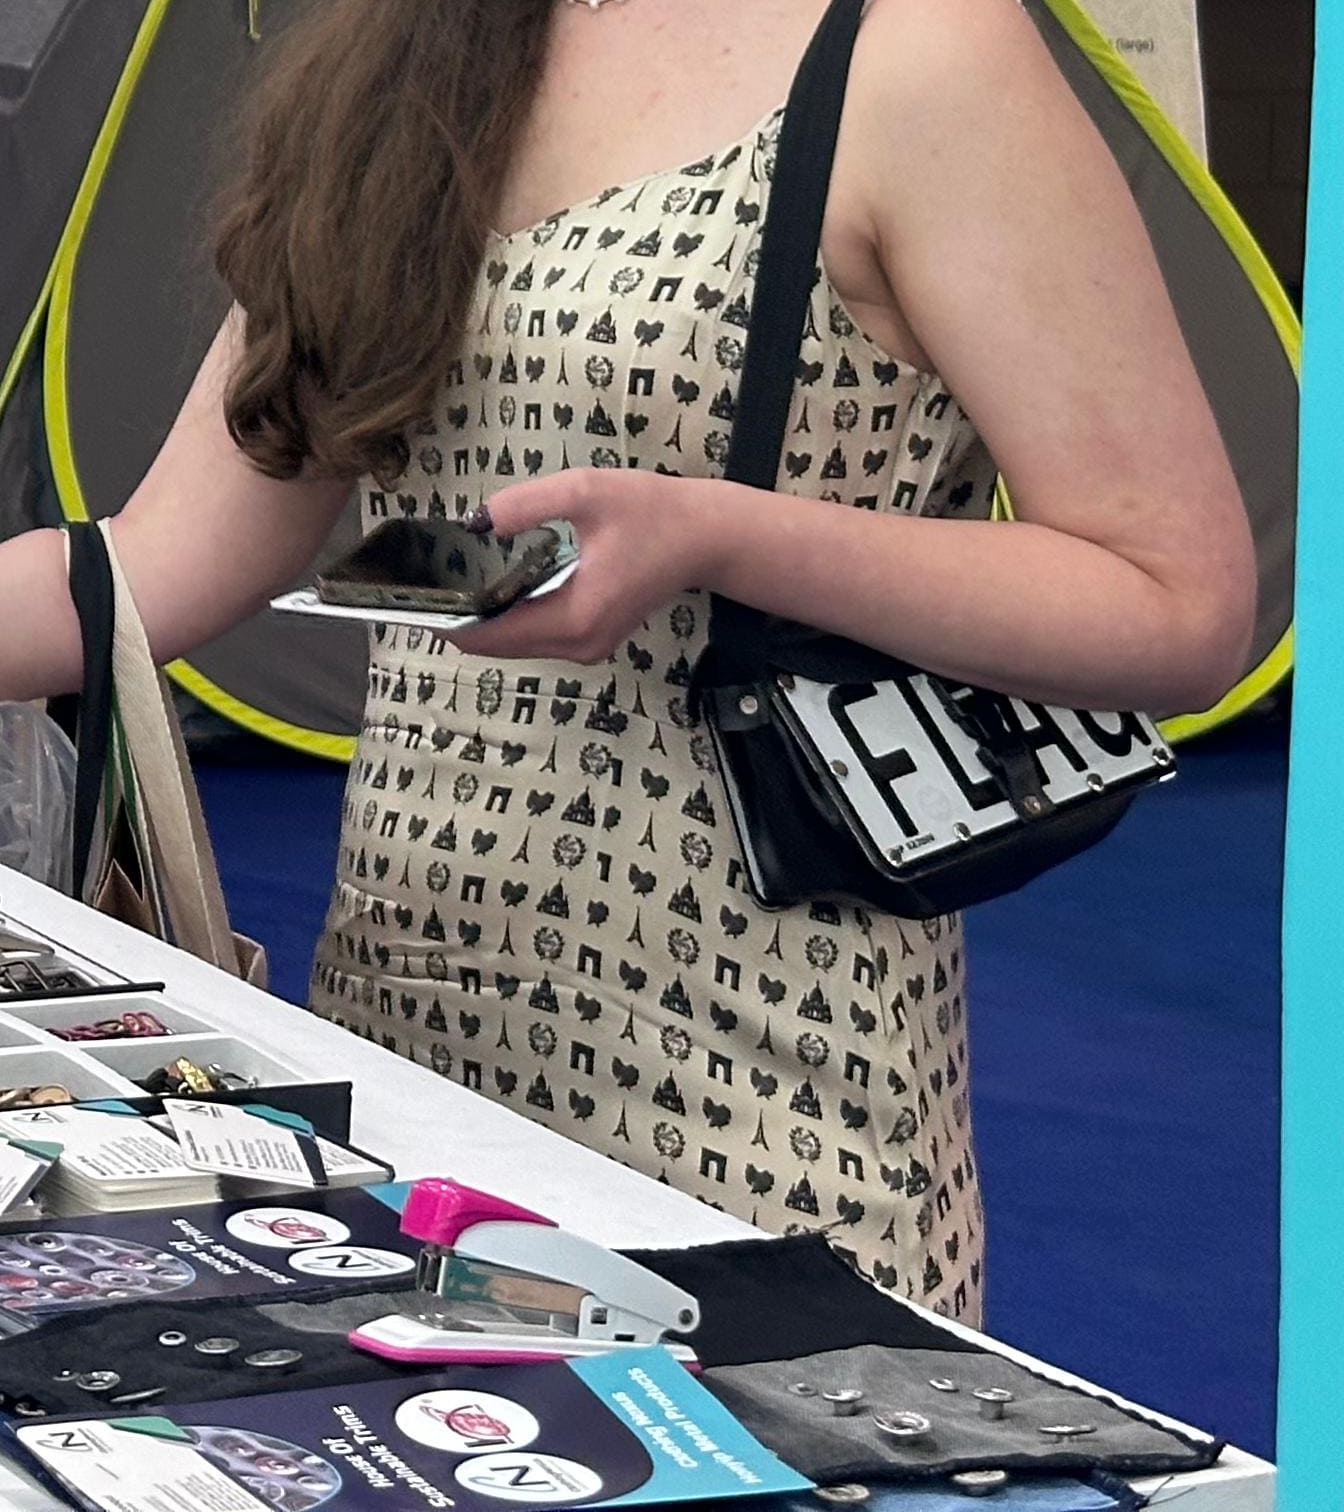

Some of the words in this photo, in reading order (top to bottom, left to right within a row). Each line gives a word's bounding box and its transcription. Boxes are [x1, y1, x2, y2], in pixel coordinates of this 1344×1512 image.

[627, 1367, 687, 1421] Products
[332, 1405, 378, 1445] Trims
[674, 1420, 719, 1452] Metal
[321, 1437, 354, 1455] Of
[344, 1454, 395, 1488] House
[368, 1444, 456, 1508] Sustainable
